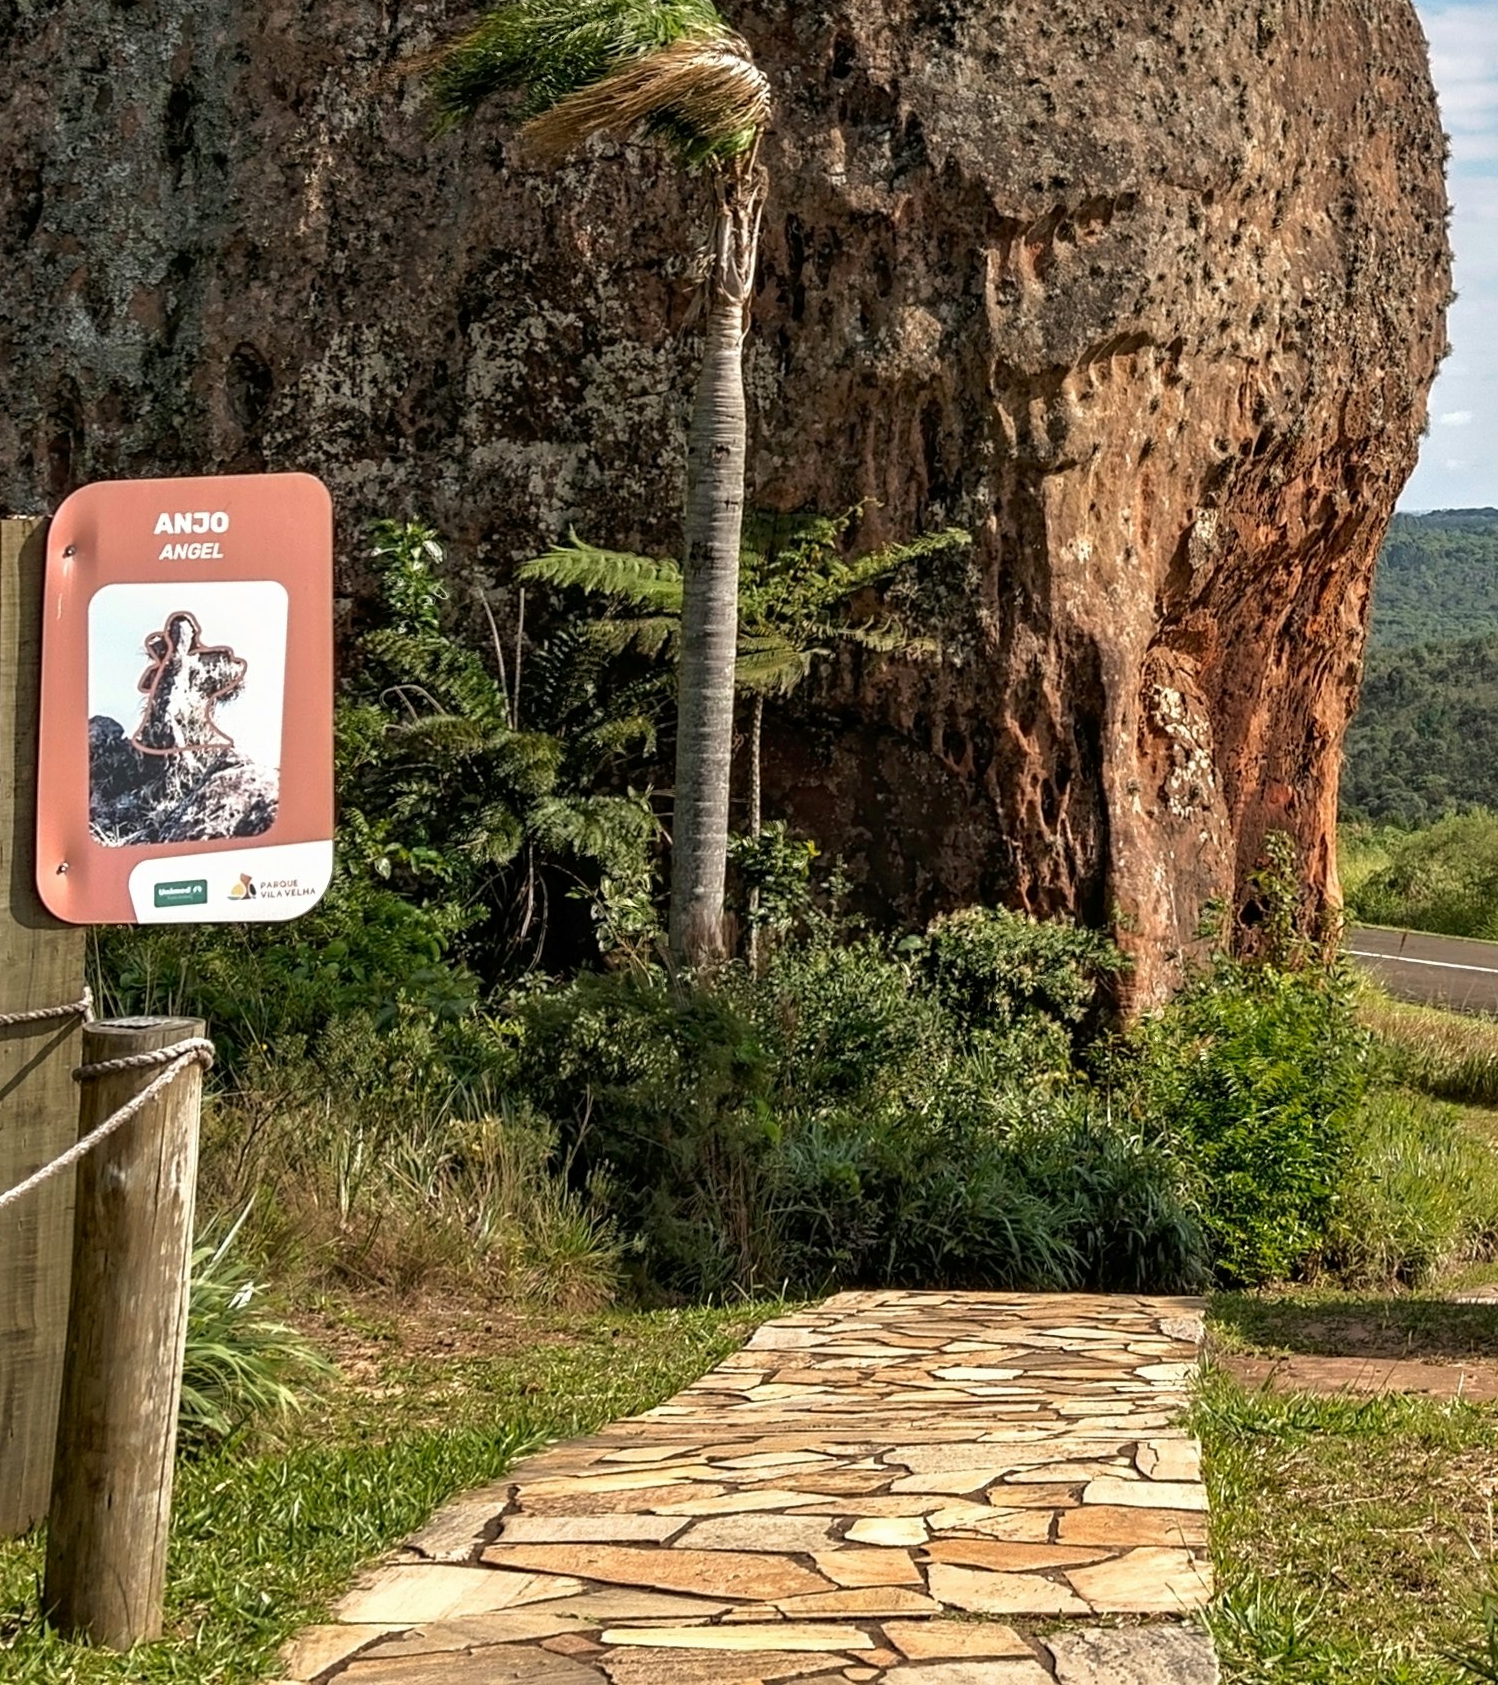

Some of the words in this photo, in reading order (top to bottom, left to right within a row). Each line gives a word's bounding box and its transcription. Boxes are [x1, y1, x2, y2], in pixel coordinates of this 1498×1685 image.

[153, 511, 230, 535] ANJO
[158, 542, 224, 560] ANGEL
[260, 879, 299, 889] PARQUE
[261, 890, 283, 899] VILA
[284, 887, 317, 897] VELHA
